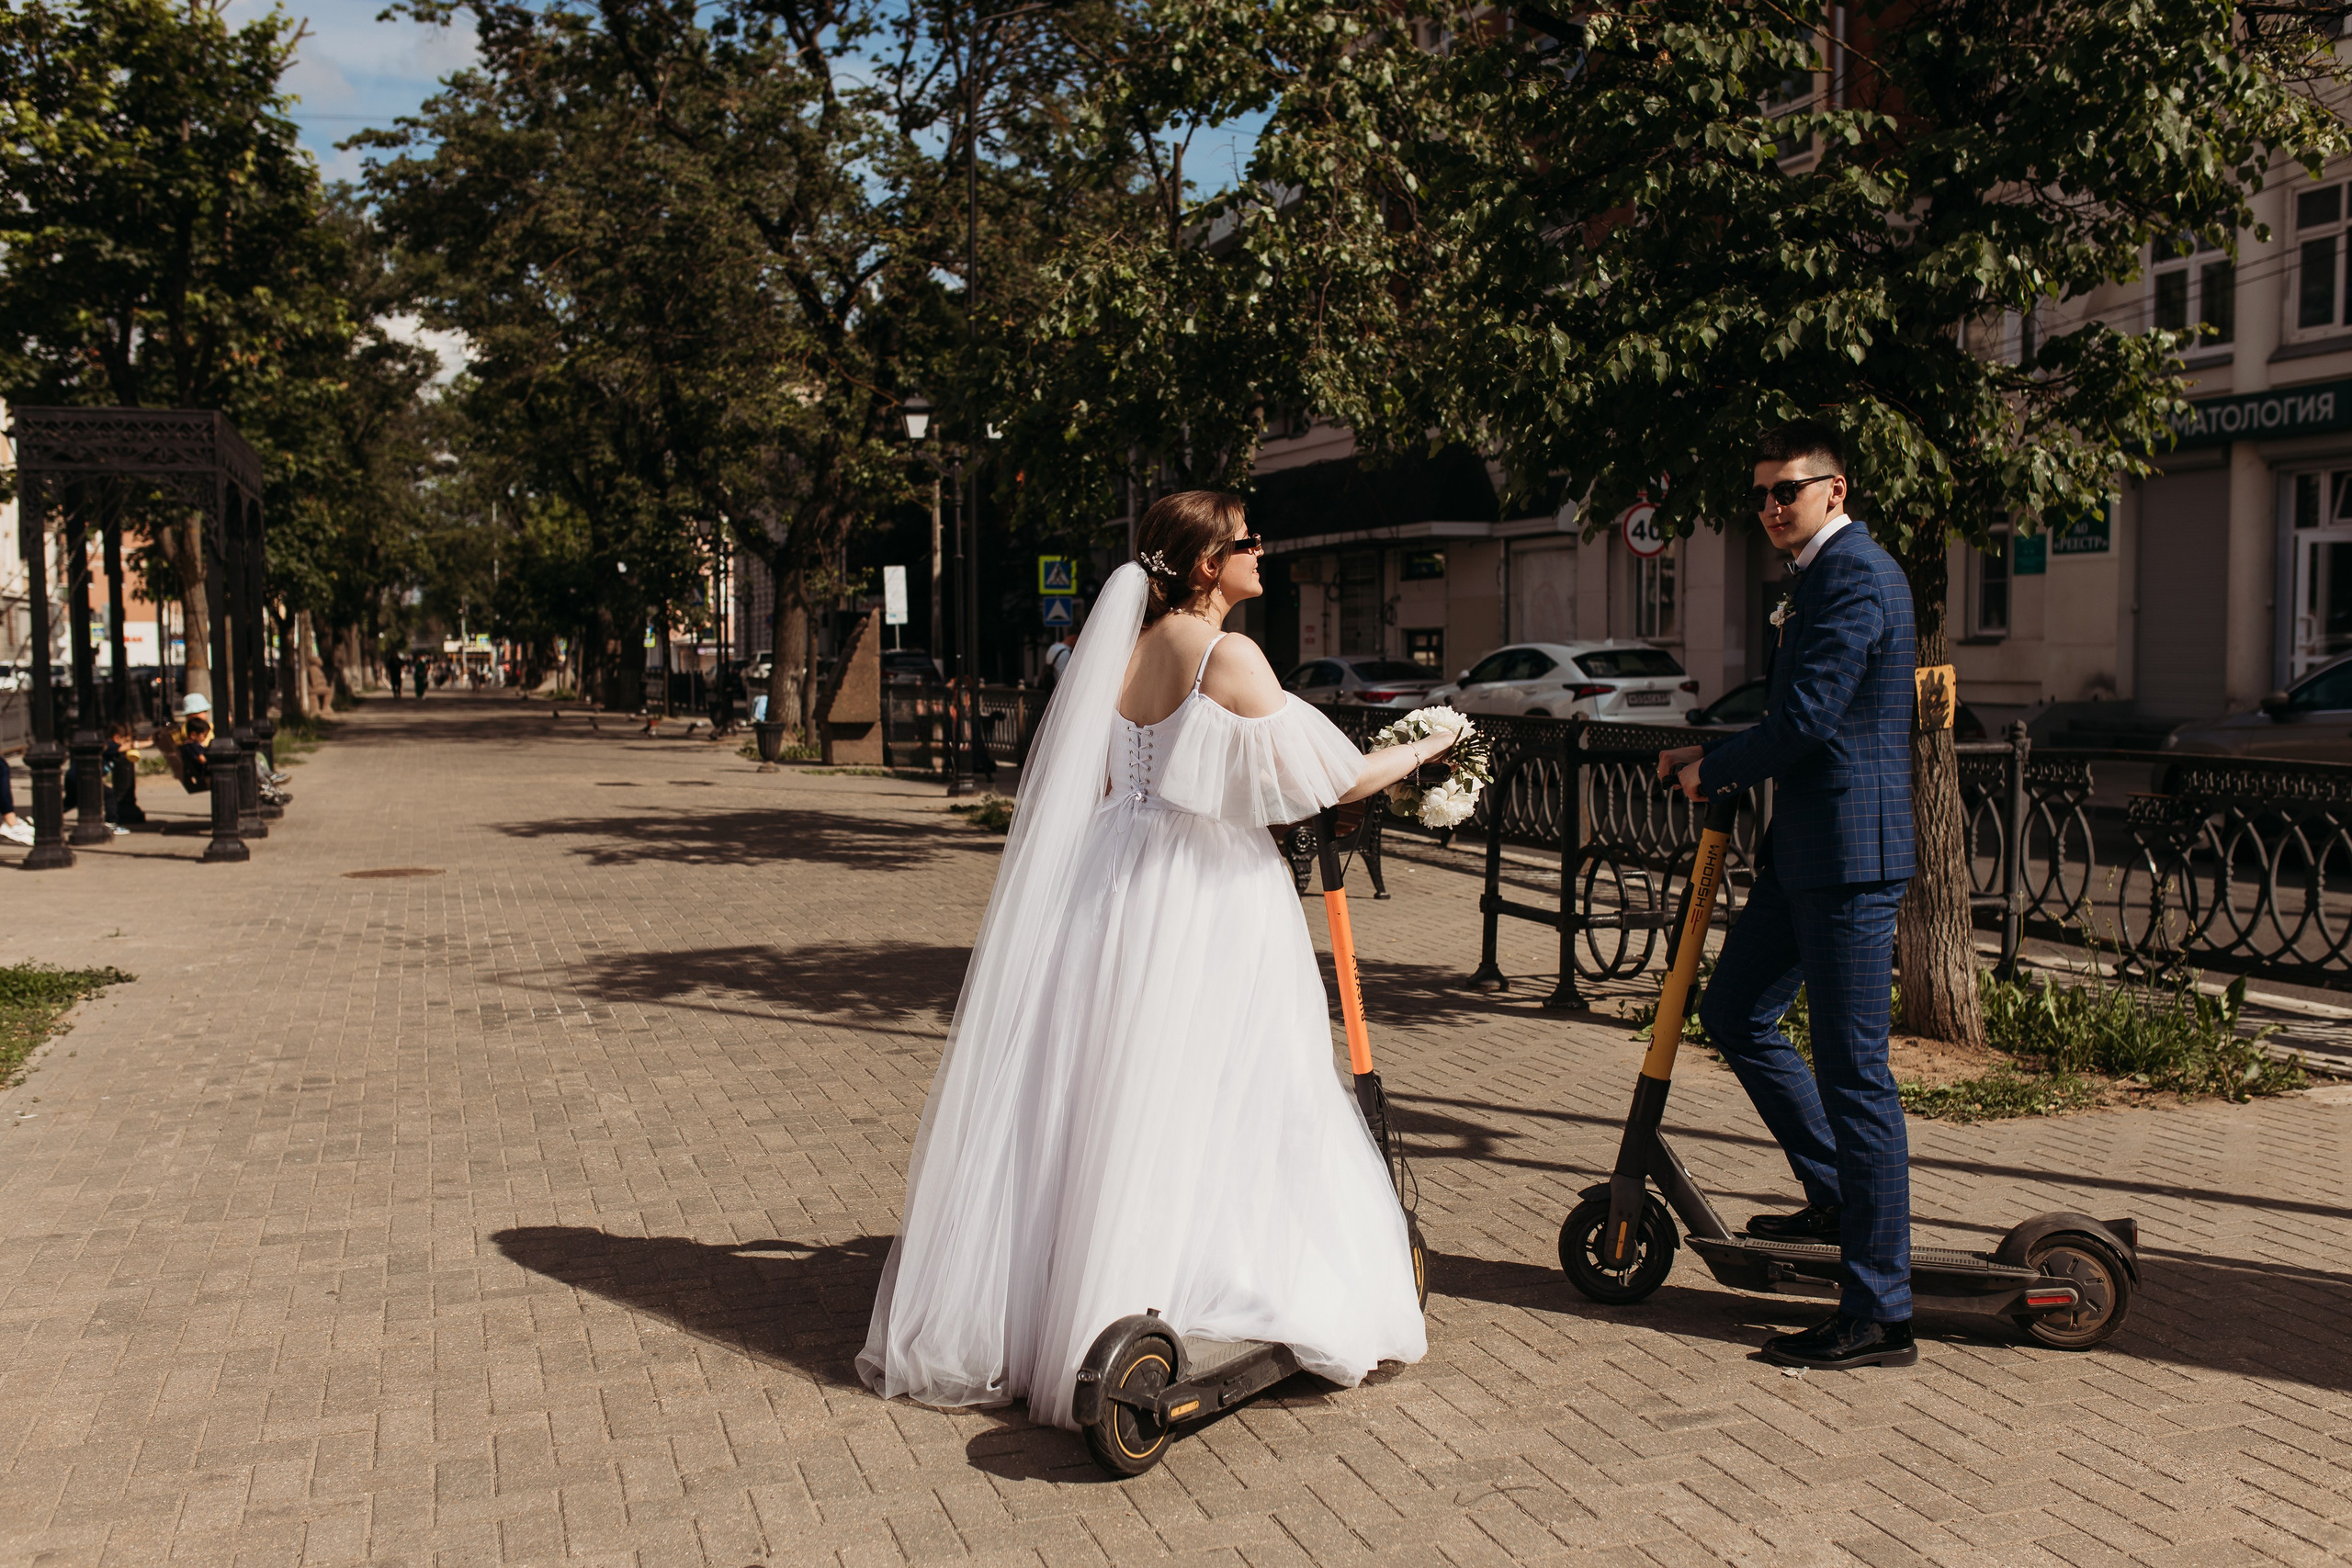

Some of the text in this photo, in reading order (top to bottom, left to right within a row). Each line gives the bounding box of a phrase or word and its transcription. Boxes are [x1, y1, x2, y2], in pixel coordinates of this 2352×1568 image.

[2123, 392, 2335, 442] МАТОЛОГИЯ
[2074, 522, 2089, 534] АО
[1695, 844, 1720, 908] WHOOSH
